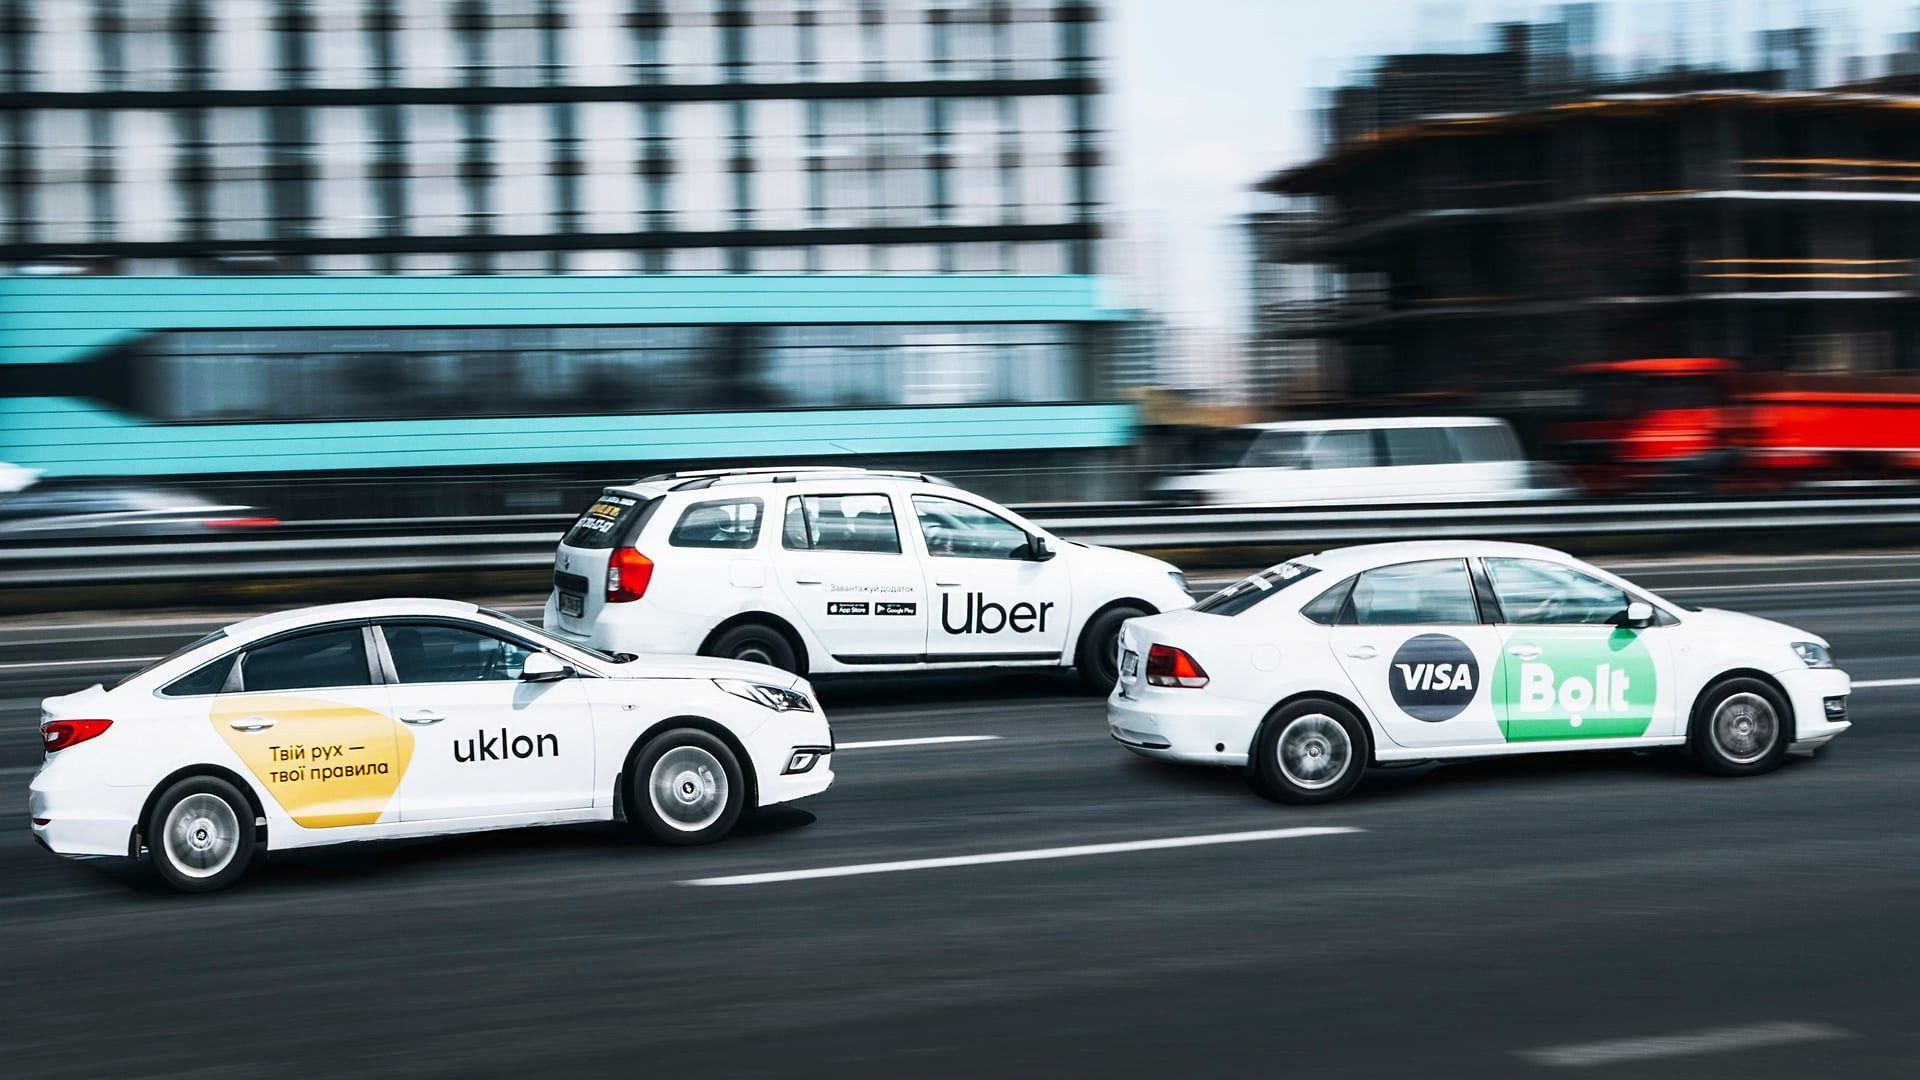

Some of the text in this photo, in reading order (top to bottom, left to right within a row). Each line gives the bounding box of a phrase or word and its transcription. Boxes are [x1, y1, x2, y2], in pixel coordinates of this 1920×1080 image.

[880, 585, 914, 593] додаток
[839, 606, 851, 614] App
[886, 607, 914, 615] Google Play
[941, 591, 1054, 635] Uber
[1394, 663, 1473, 691] VISA
[1519, 662, 1630, 728] Bolt
[269, 744, 305, 762] Твій
[311, 745, 343, 761] рух
[453, 727, 559, 763] uklon
[269, 762, 389, 783] твої правила
